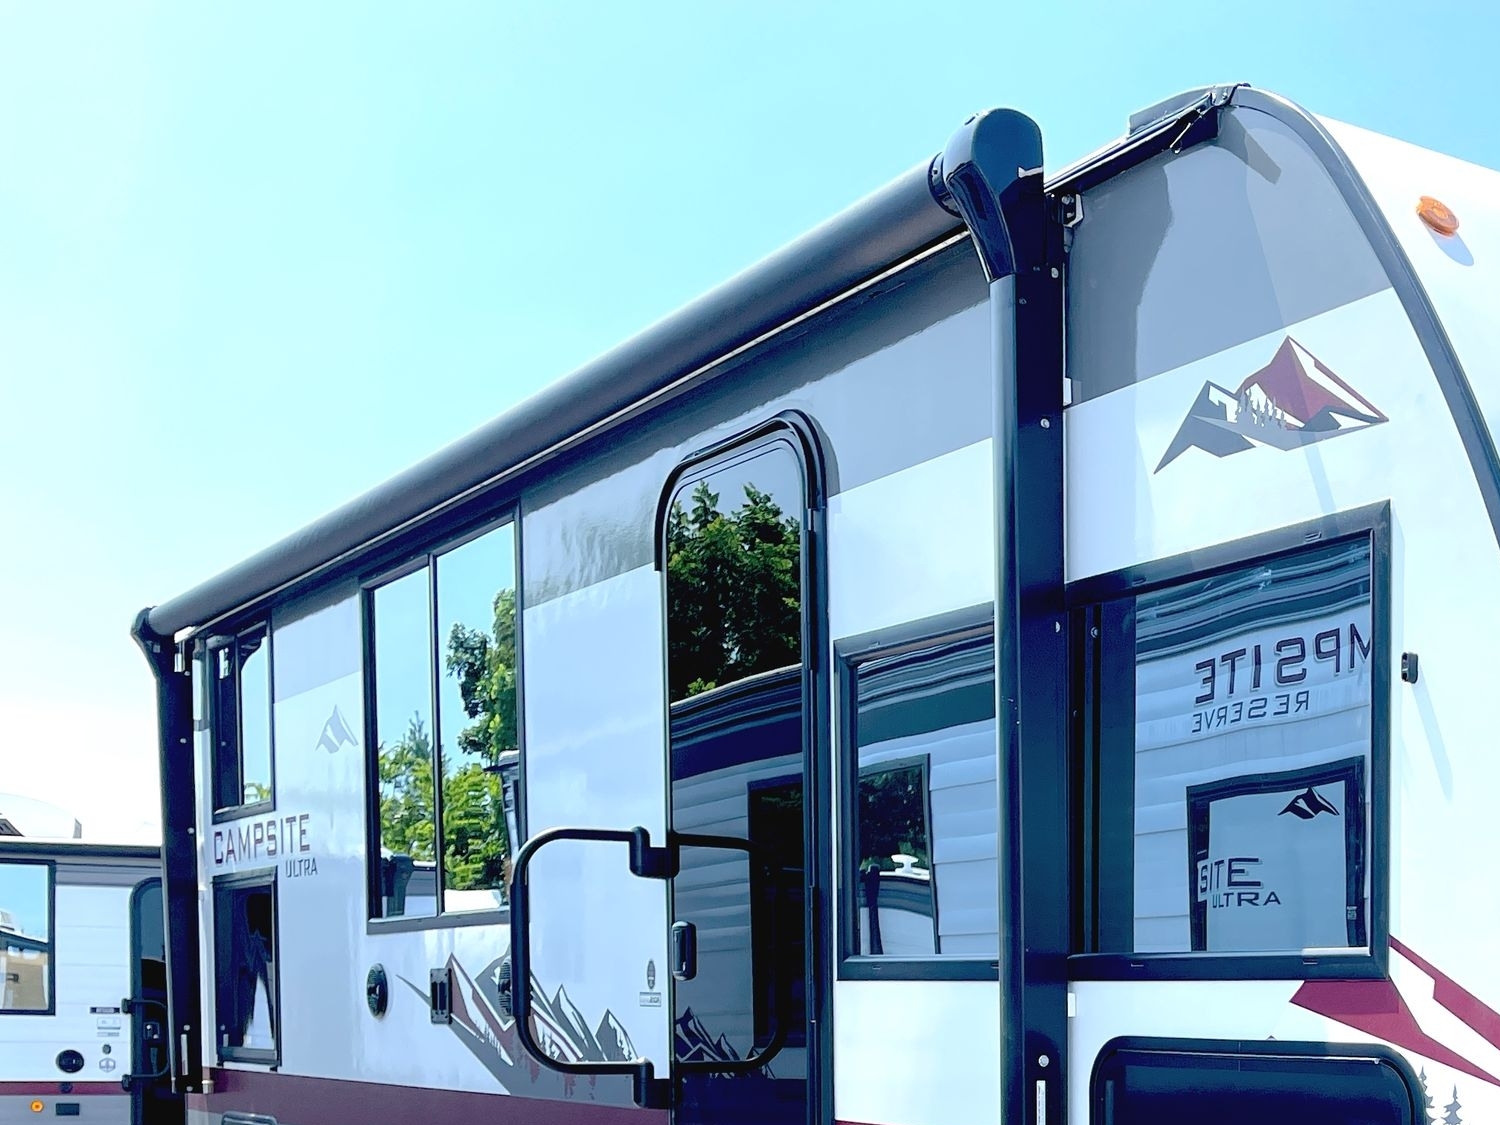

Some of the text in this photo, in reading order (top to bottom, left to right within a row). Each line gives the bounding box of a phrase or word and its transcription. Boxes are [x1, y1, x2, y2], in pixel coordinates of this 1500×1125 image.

[213, 813, 311, 864] CAMPSITE
[285, 858, 318, 878] ULTRA
[1212, 892, 1281, 907] ULTRA
